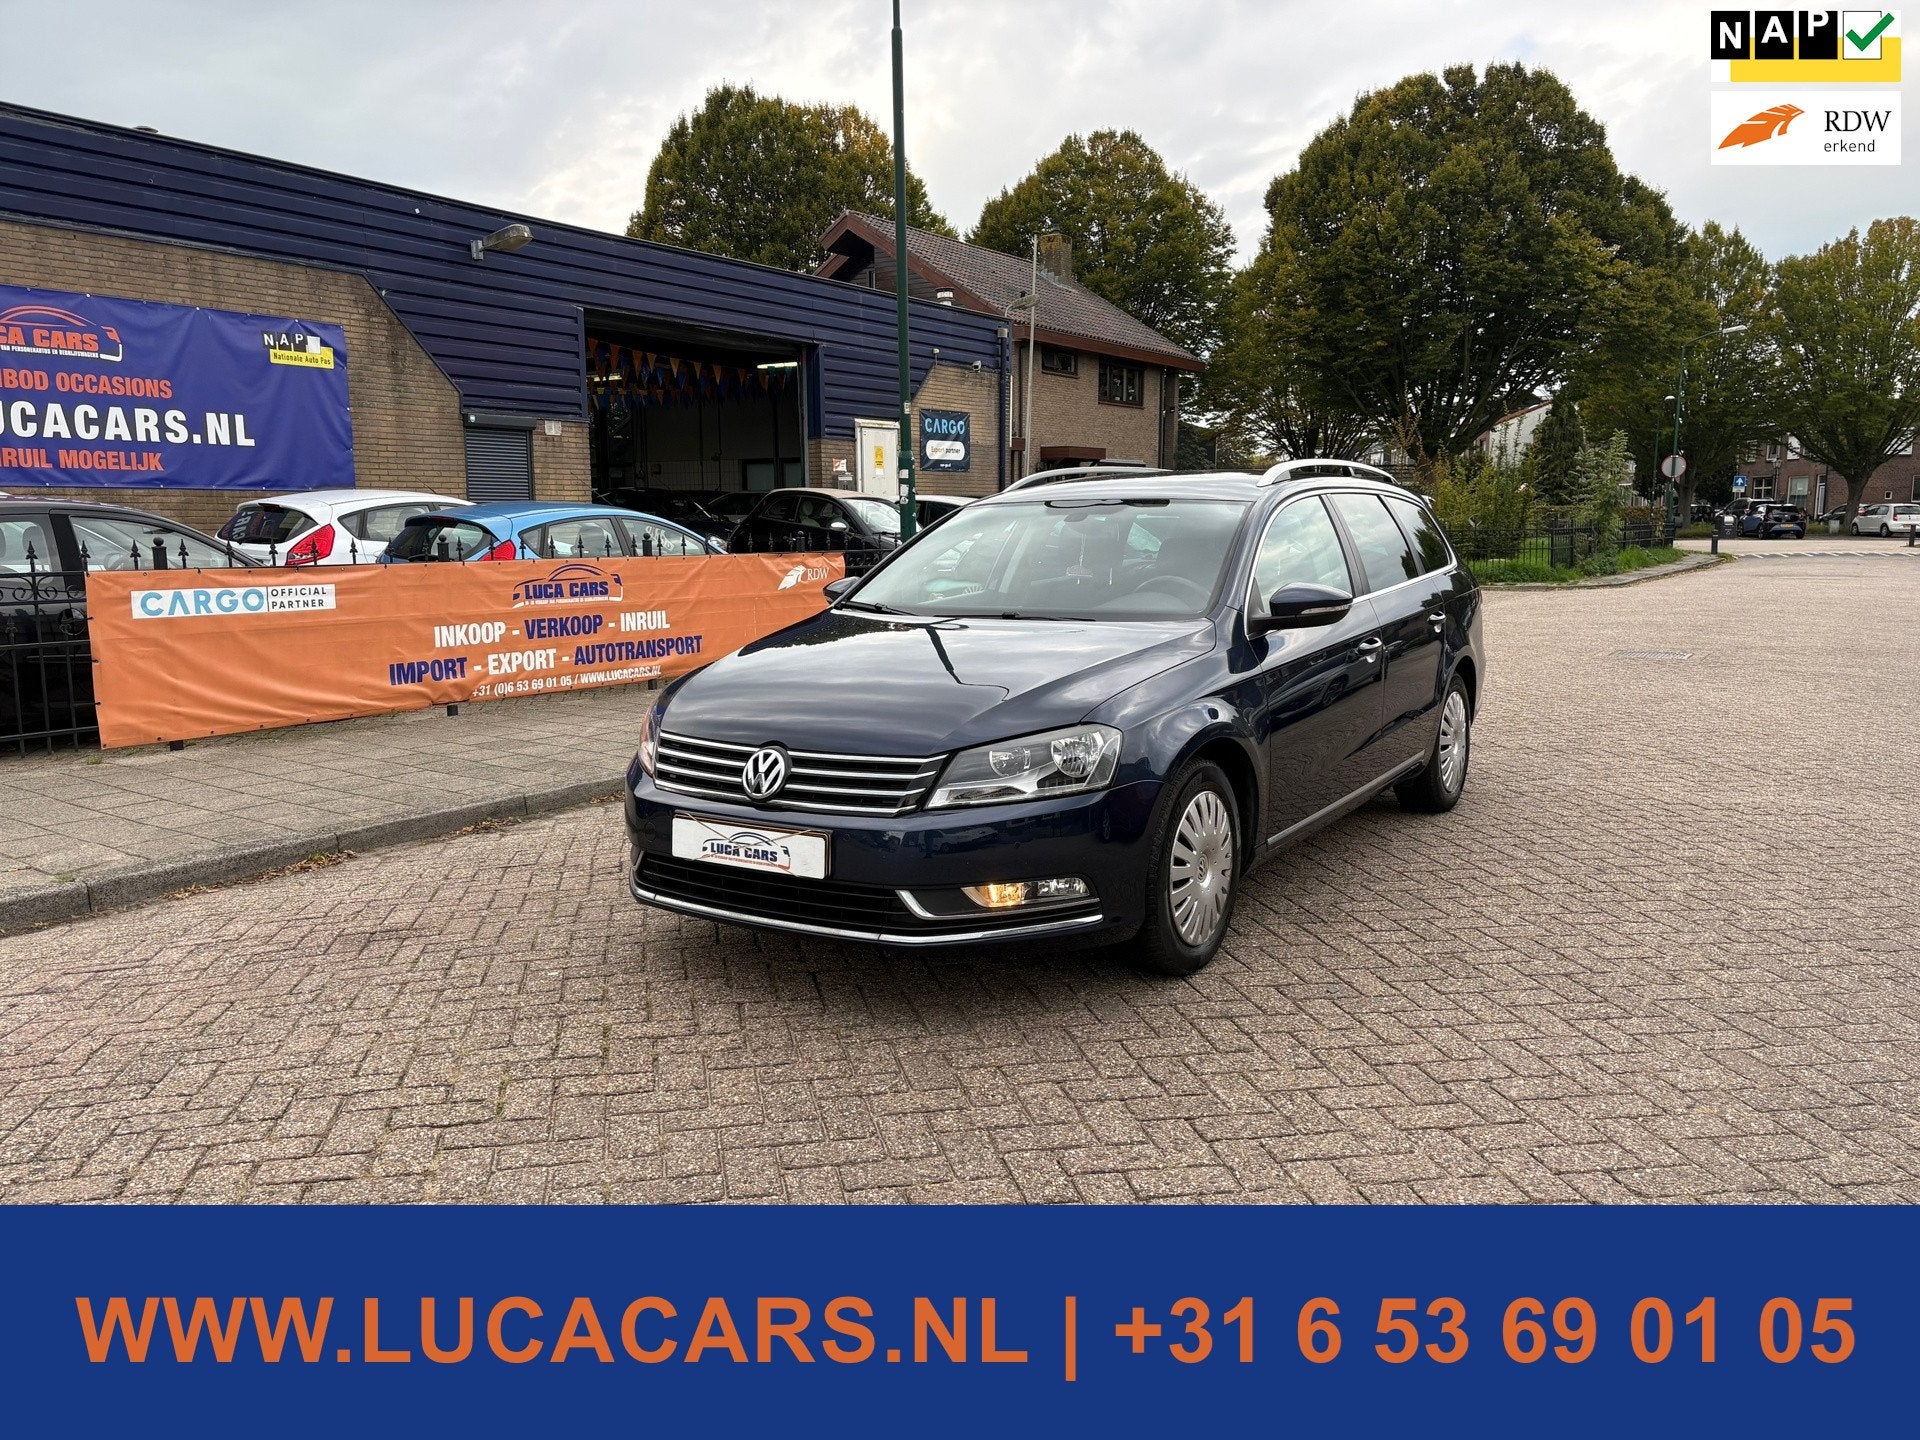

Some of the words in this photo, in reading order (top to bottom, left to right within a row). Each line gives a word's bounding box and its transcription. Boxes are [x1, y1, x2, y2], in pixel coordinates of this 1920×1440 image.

[32, 328, 99, 352] CARS
[263, 333, 304, 346] NAP
[273, 352, 303, 363] Nationale
[305, 355, 319, 364] Auto
[321, 356, 331, 365] Pas
[0, 368, 49, 391] BOD
[56, 372, 173, 399] OCCASIONS
[0, 400, 256, 447] CACARS.NL
[924, 417, 965, 435] CARGO
[0, 447, 53, 468] RUIL
[59, 449, 165, 472] MOGELIJK
[807, 567, 830, 581] RDW
[270, 586, 327, 598] OFFICIAL
[524, 583, 565, 600] LUCA
[569, 581, 609, 597] CARS
[140, 588, 265, 617] CARGO
[271, 599, 325, 610] PARTNER
[433, 621, 506, 648] INKOOP
[524, 615, 603, 640] VERKOOP
[620, 610, 670, 632] INRUIL
[389, 657, 467, 686] IMPORT
[487, 648, 557, 676] EXPORT
[574, 635, 703, 666] AUTOTRANSPORT
[472, 684, 491, 697] +31
[494, 681, 514, 697] (0)6
[516, 680, 529, 692] 53
[531, 679, 544, 691] 69
[546, 677, 557, 688] 01
[560, 675, 572, 687] 05
[579, 665, 662, 684] WWW.LUCACARS.NL
[710, 842, 740, 857] LUCA
[744, 847, 778, 862] CARS
